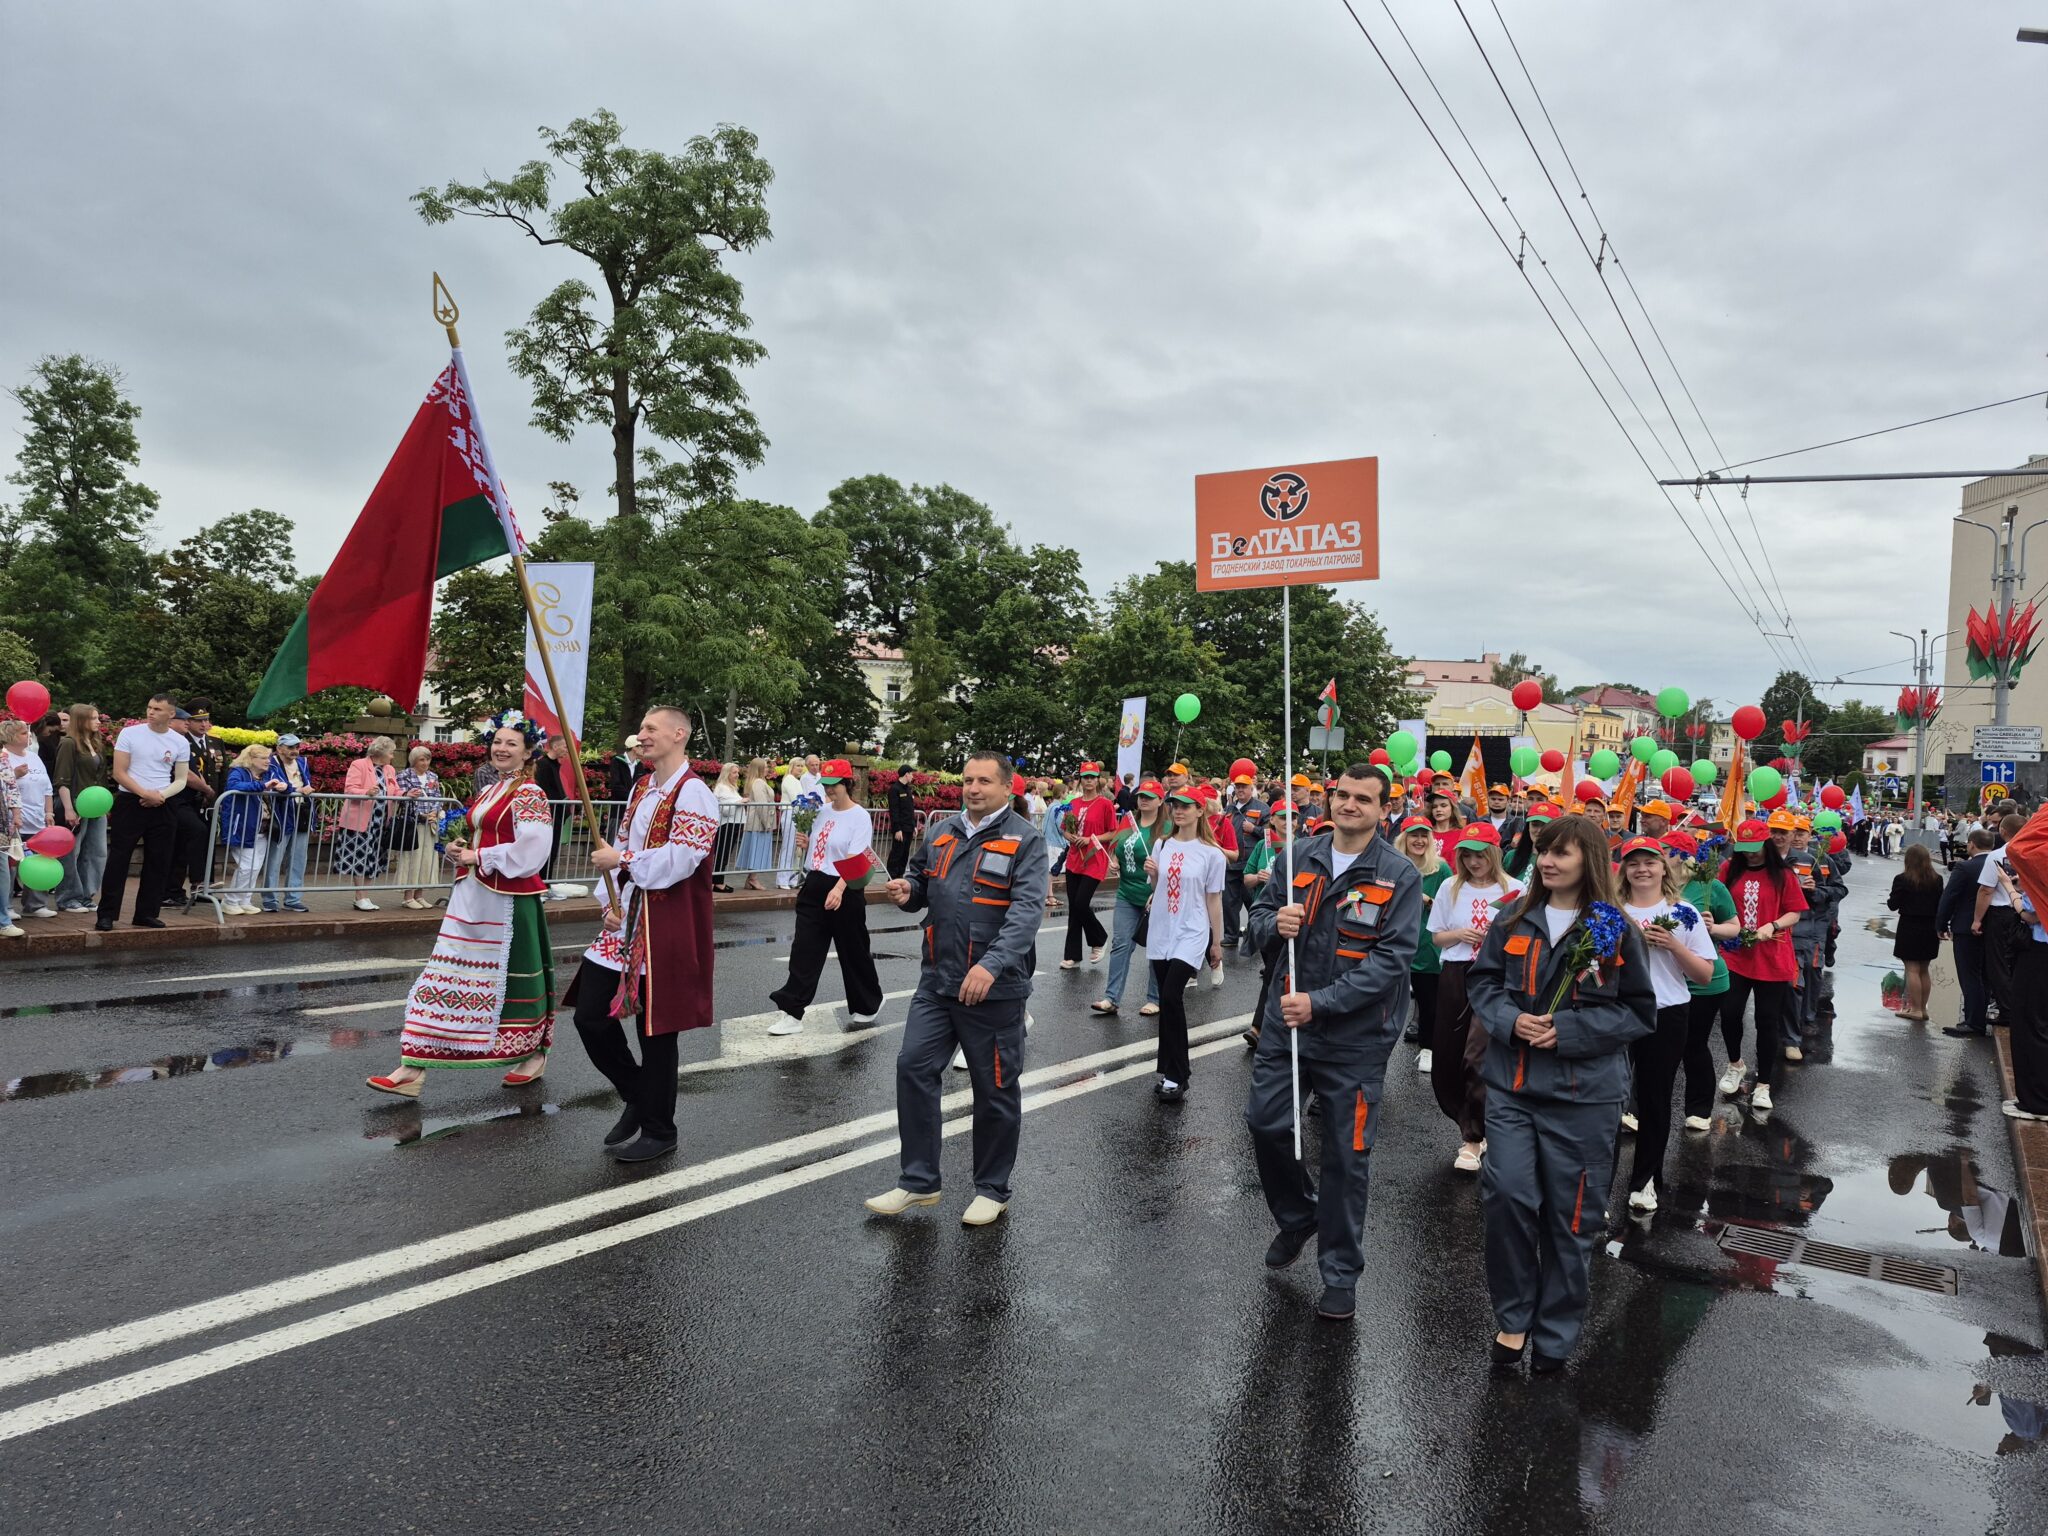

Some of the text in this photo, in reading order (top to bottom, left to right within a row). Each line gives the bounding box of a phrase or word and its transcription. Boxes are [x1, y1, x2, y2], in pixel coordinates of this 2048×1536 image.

[1213, 553, 1361, 575] ГРОДНЕНСКИЙ ЗАВОД ТОКАРНЫХ ПАТРОНОВ
